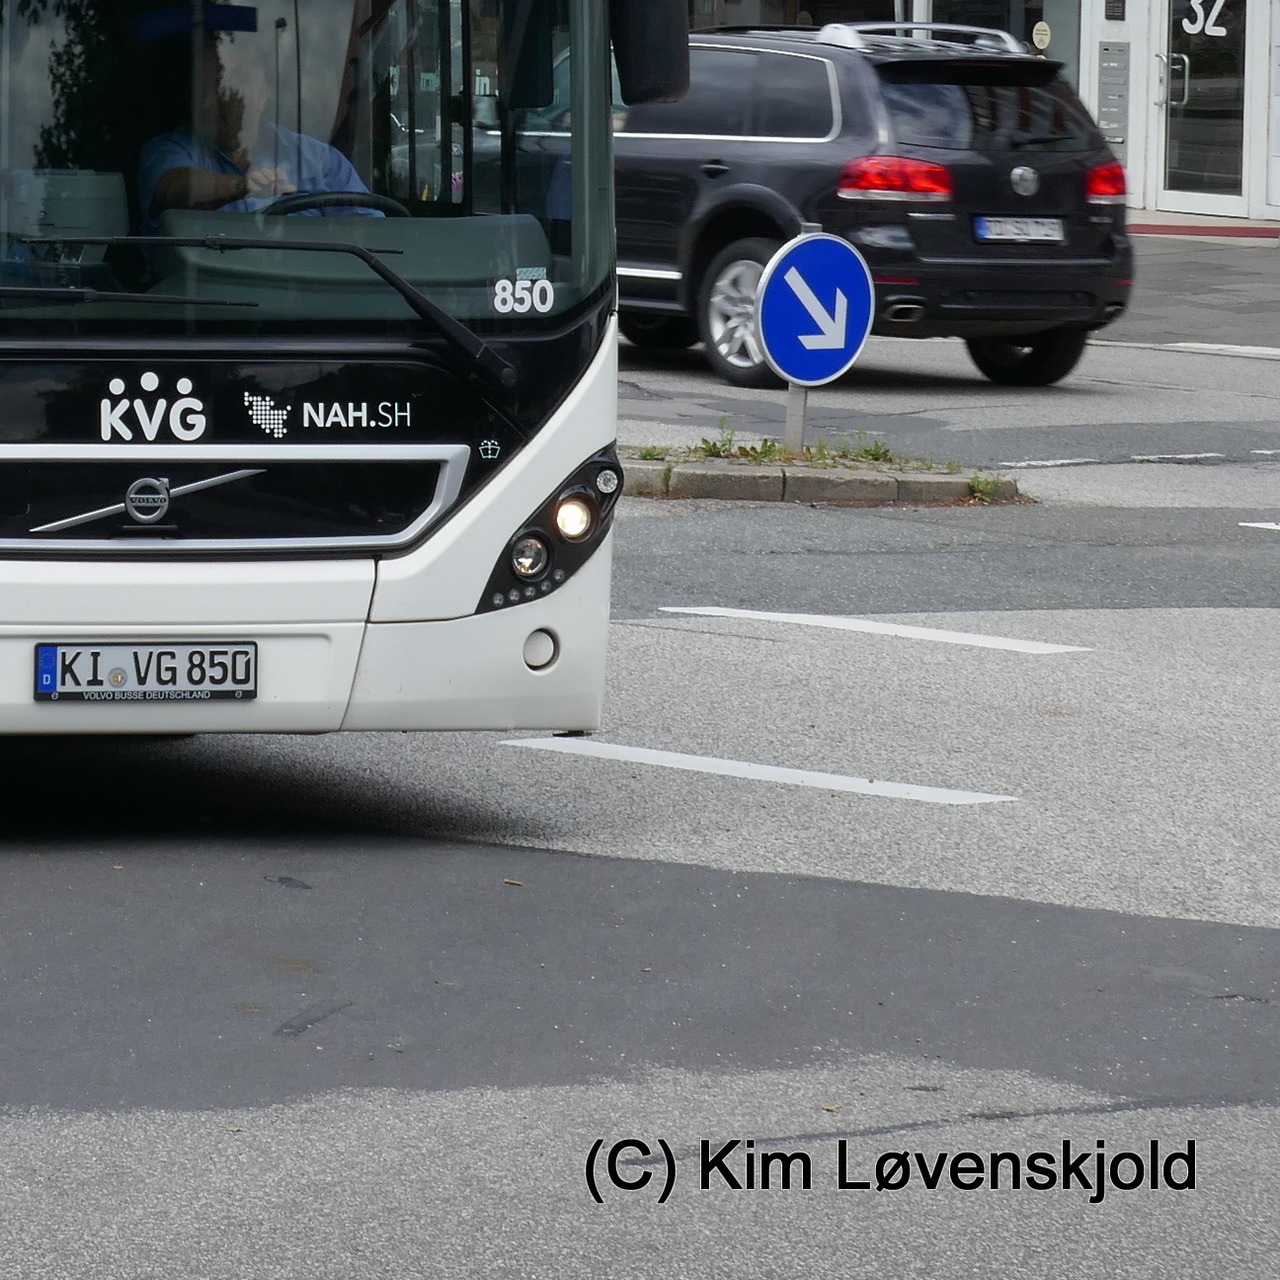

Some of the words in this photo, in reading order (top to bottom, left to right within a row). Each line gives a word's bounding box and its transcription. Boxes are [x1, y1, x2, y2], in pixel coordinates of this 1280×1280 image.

[494, 279, 554, 313] 850
[101, 398, 206, 441] KVG
[303, 402, 410, 427] NAH.SH
[129, 496, 167, 506] VOLVO
[43, 674, 51, 685] D
[60, 651, 104, 686] KI
[132, 651, 177, 686] VG
[187, 650, 251, 686] 850
[83, 691, 113, 700] VOLVO
[115, 691, 144, 700] BUSSE
[147, 691, 211, 700] DEUTSCHLAND
